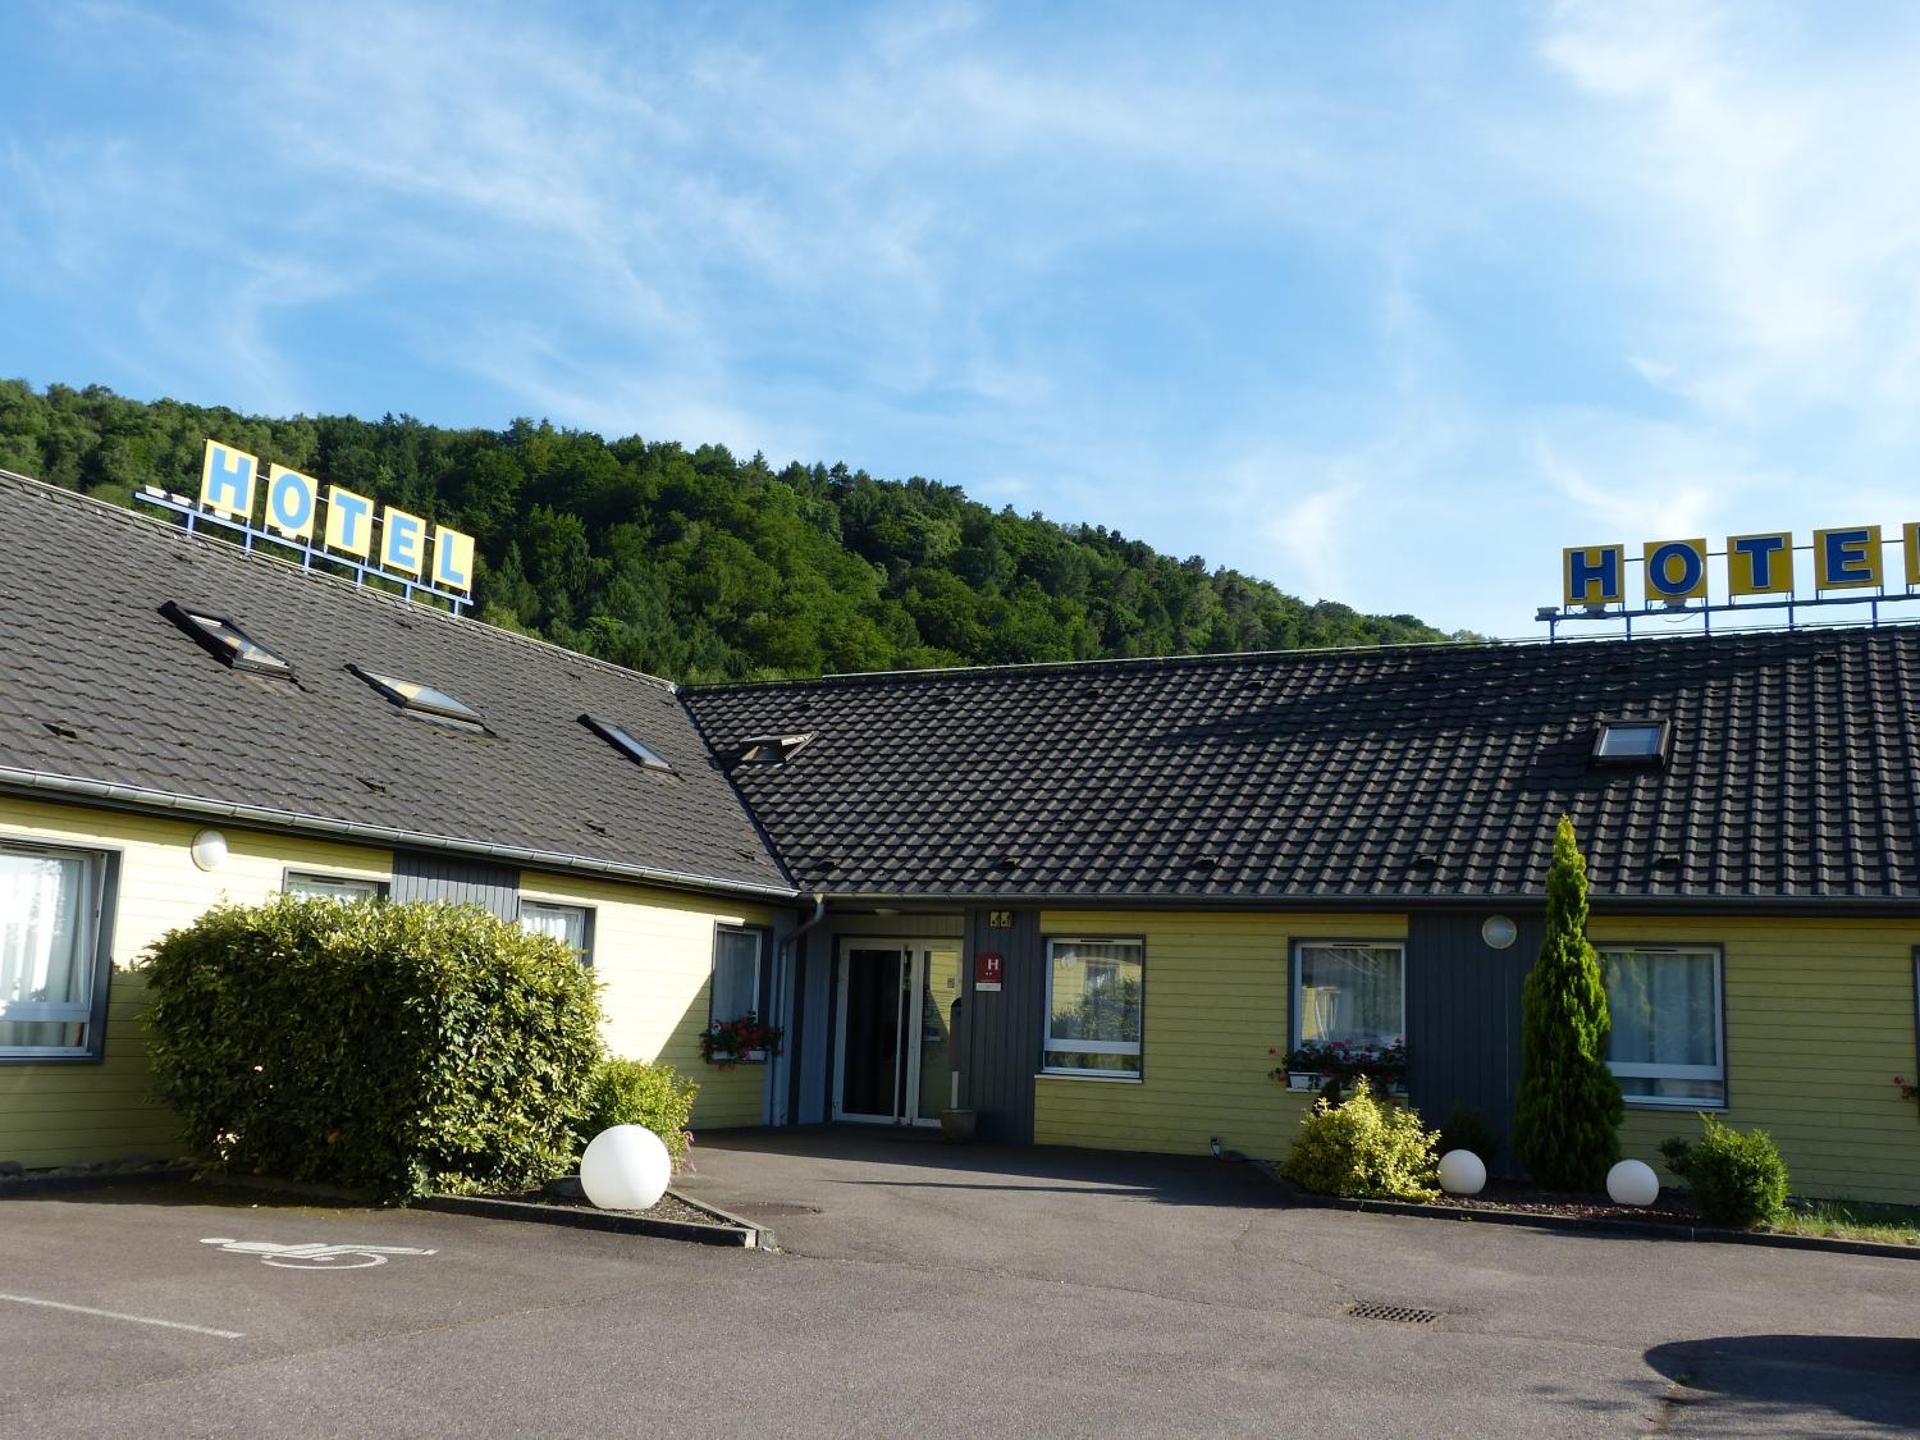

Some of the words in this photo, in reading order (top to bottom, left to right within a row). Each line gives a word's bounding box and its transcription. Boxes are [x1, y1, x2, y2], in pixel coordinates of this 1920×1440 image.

[207, 446, 465, 585] HOTEL
[1570, 526, 1920, 600] HOTE
[988, 959, 998, 970] H
